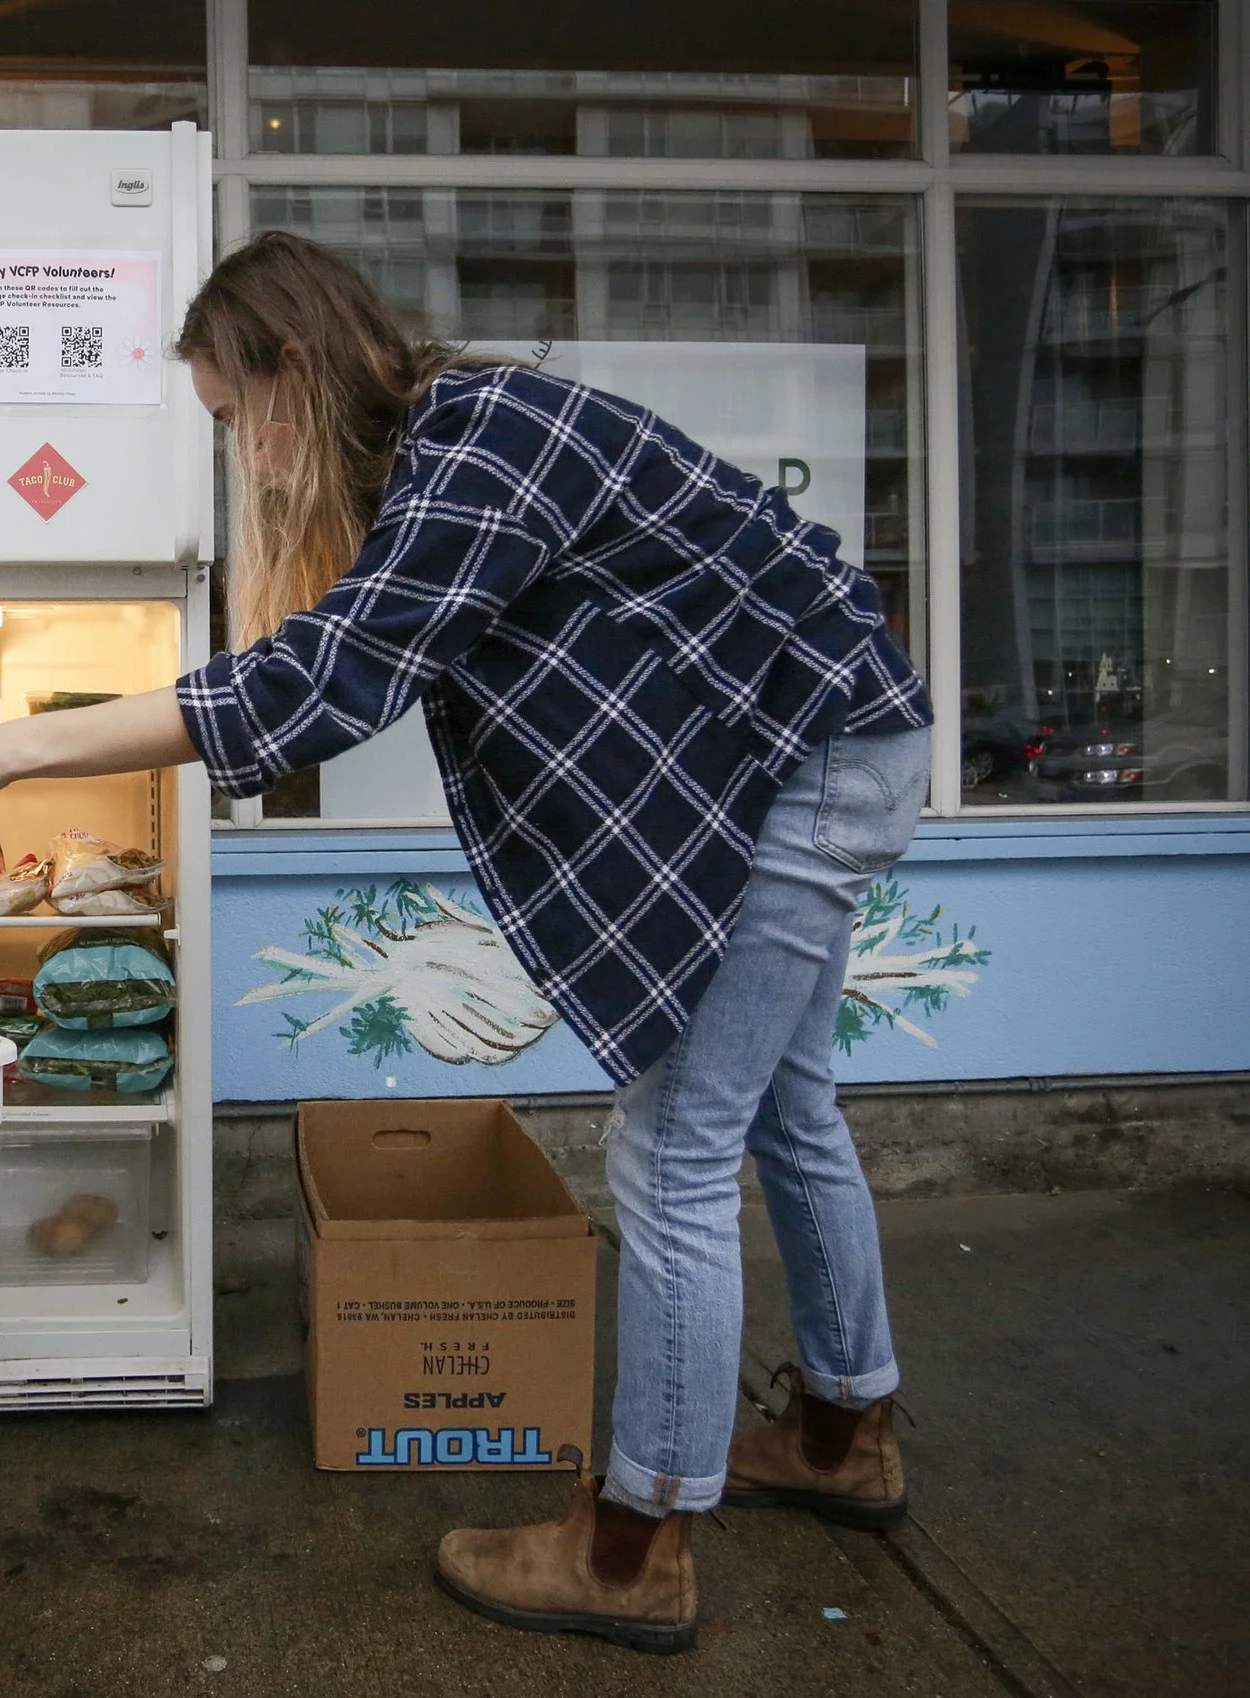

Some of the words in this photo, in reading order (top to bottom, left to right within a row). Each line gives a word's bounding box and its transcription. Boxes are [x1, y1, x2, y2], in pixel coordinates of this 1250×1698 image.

[117, 179, 146, 191] Inglis
[9, 265, 40, 278] VCFP
[42, 266, 116, 279] Volunteers!
[24, 284, 36, 292] QR
[18, 475, 43, 487] TACO
[52, 475, 76, 488] CLUB
[343, 1301, 360, 1310] CAT
[369, 1301, 402, 1310] BUSHEL
[404, 1301, 440, 1310] VOLUME
[441, 1301, 460, 1310] ONE
[467, 1301, 492, 1310] U.S.A.
[494, 1301, 506, 1309] OF
[508, 1300, 549, 1309] PRODUCE
[557, 1299, 576, 1308] SIZE
[381, 1312, 420, 1321] CHELAN,
[430, 1313, 459, 1321] FRESH
[463, 1312, 499, 1321] CHELAN
[502, 1312, 514, 1320] BY
[517, 1311, 576, 1320] DISTRIBUTED
[423, 1356, 490, 1375] CHELAN
[403, 1392, 507, 1410] APPLES
[356, 1427, 552, 1466] TROUT
